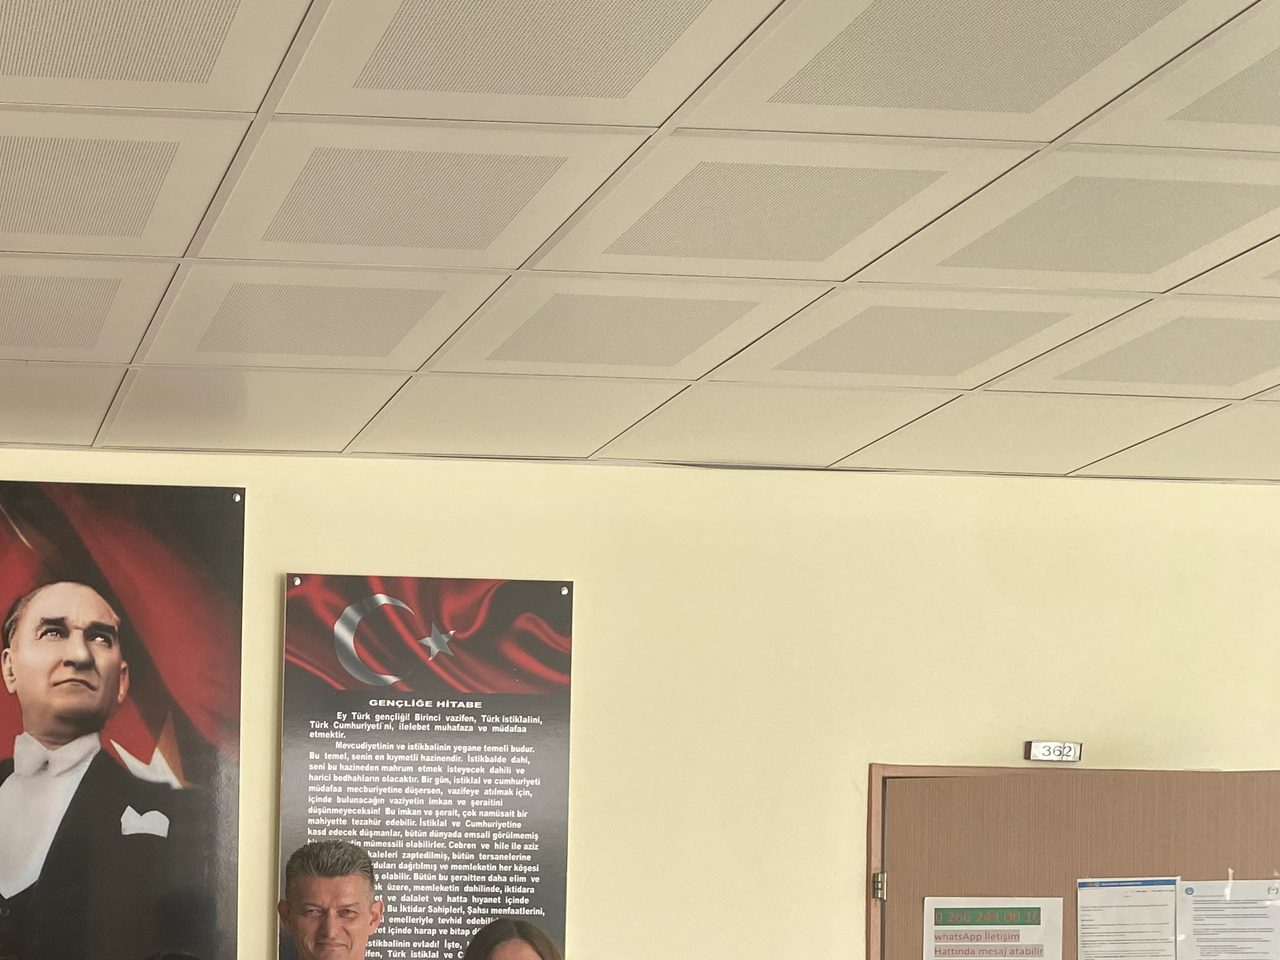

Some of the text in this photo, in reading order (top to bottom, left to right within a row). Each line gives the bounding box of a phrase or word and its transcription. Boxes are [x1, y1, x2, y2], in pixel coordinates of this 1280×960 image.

[369, 699, 481, 709] GENÇLİĞE HİTABE
[336, 711, 346, 722] Ey
[352, 711, 370, 721] Türk
[374, 712, 410, 723] gençliği!
[414, 712, 440, 722] Birinci
[445, 713, 476, 724] vazifen,
[482, 714, 500, 723] Türk
[310, 719, 328, 729] Türk
[398, 721, 430, 730] ilelebet
[434, 722, 473, 731] muhafaza
[492, 723, 526, 732] müdafaa
[309, 729, 345, 739] etmektir.
[453, 744, 481, 753] yegane
[483, 742, 508, 752] temeli
[510, 743, 534, 752] budur.
[1042, 745, 1072, 757] 362
[309, 750, 319, 760] Bu
[324, 751, 349, 762] temel,
[351, 751, 372, 761] senin
[386, 752, 418, 763] kıymetli
[510, 754, 530, 765] dahi,
[308, 761, 325, 771] seni
[327, 762, 337, 771] bu
[339, 762, 379, 772] hazineden
[381, 762, 413, 772] mahrum
[417, 763, 442, 773] etmek
[447, 764, 484, 775] isteyecek
[489, 764, 511, 774] dahili
[308, 772, 330, 782] harici
[421, 774, 432, 783] Bir
[434, 774, 451, 785] gün,
[453, 774, 480, 784] istiklal
[308, 783, 342, 793] müdafaa
[404, 785, 442, 796] düşersen,
[447, 785, 479, 797] vazifeye
[483, 786, 513, 795] atılmak
[515, 786, 532, 797] için,
[308, 794, 332, 805] içinde
[389, 795, 424, 807] vaziyetin
[428, 796, 452, 806] imkan
[470, 797, 502, 808] şeraitini
[385, 806, 395, 815] Bu
[397, 806, 421, 816] imkan
[435, 807, 460, 818] şerait,
[462, 807, 476, 818] çok
[478, 807, 514, 817] namüsait
[516, 808, 527, 817] bir
[307, 816, 346, 827] mahiyette
[351, 816, 380, 826] tezahür
[385, 817, 416, 826] edebilir.
[419, 817, 447, 827] İstiklal
[307, 827, 326, 836] kasd
[328, 827, 357, 836] edecek
[404, 828, 427, 838] bütün
[429, 828, 462, 840] dünyada
[464, 829, 490, 838] emsali
[387, 903, 397, 913] Bu
[934, 931, 1020, 942] whatsApp İletişim
[934, 946, 1044, 957] Hattında mesaj atabilir
